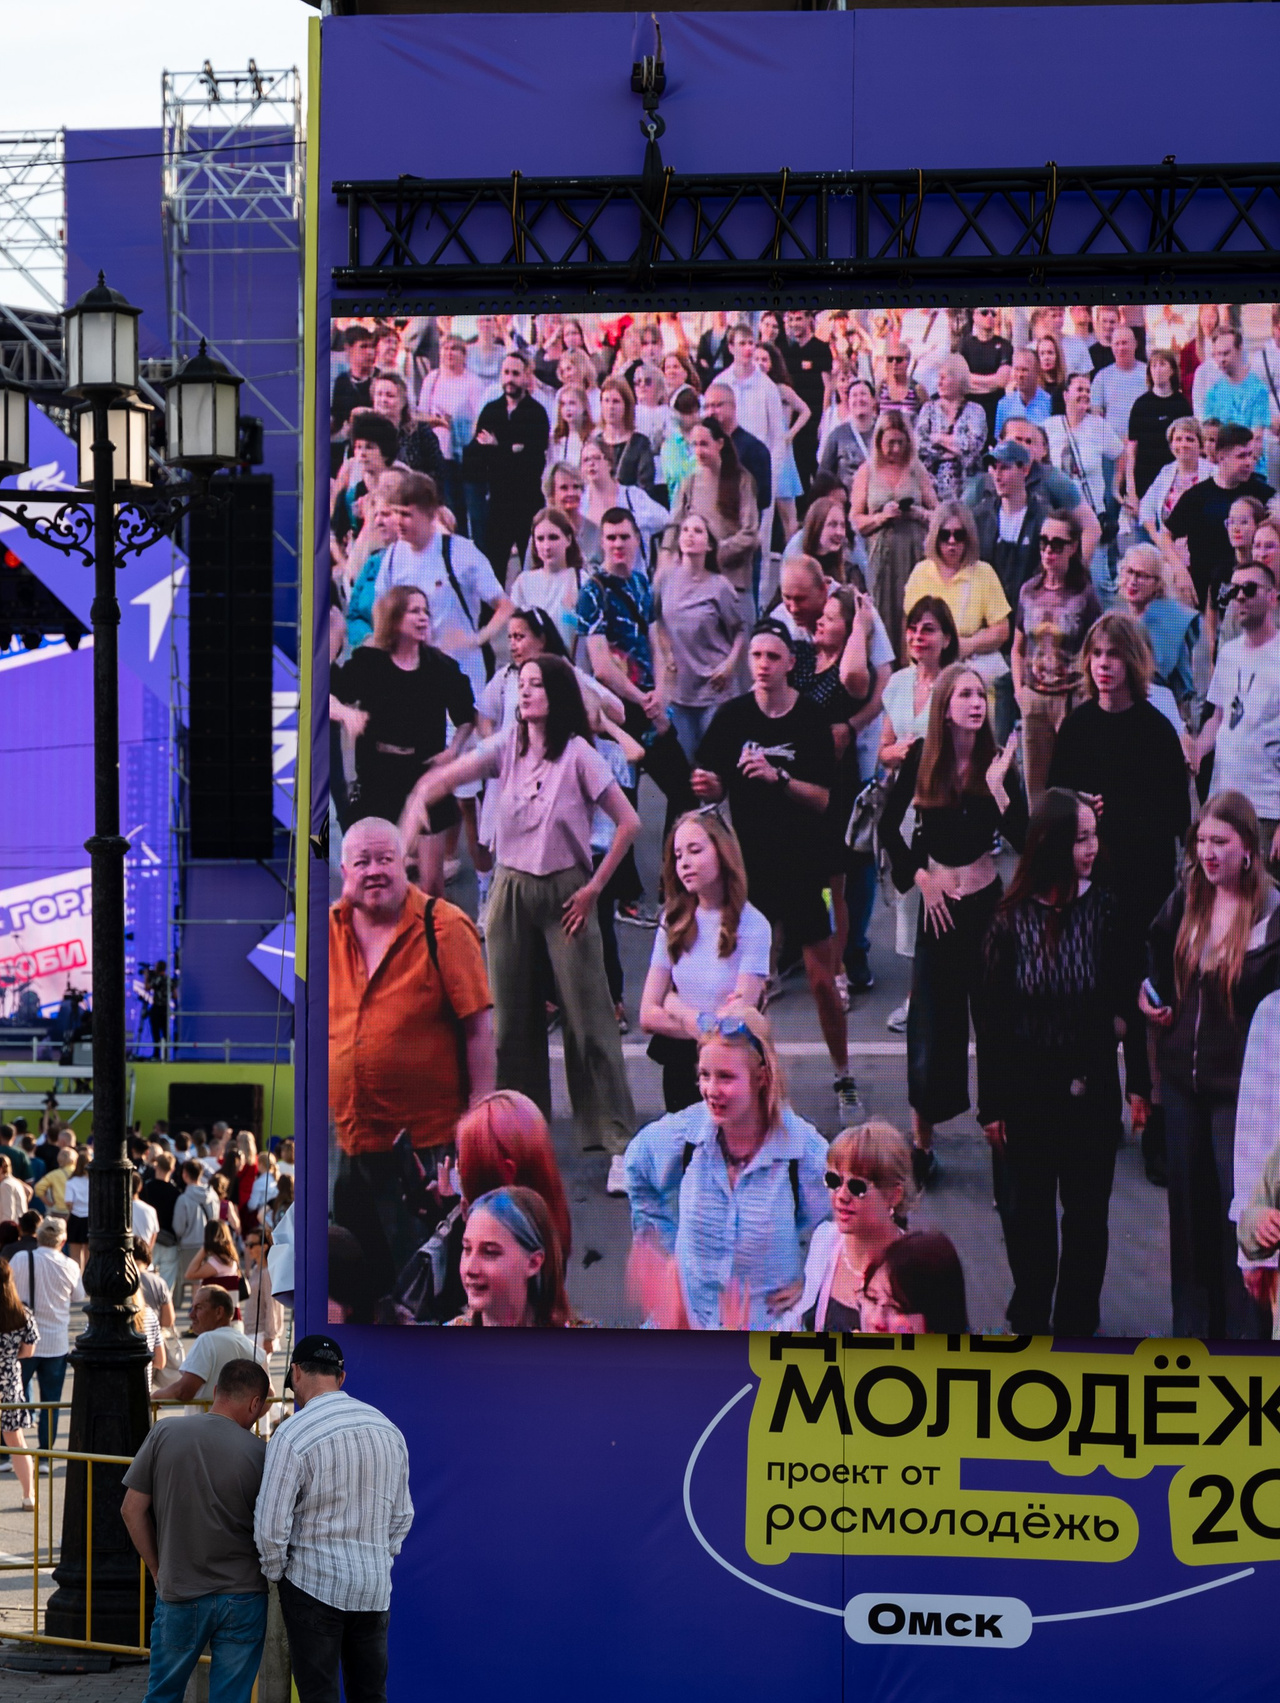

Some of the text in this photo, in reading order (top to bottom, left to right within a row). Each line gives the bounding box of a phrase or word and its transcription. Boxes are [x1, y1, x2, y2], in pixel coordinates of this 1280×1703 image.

[767, 1461, 941, 1490] проект от
[765, 1502, 1120, 1546] росмолодёжь
[867, 1602, 1004, 1639] Омск
